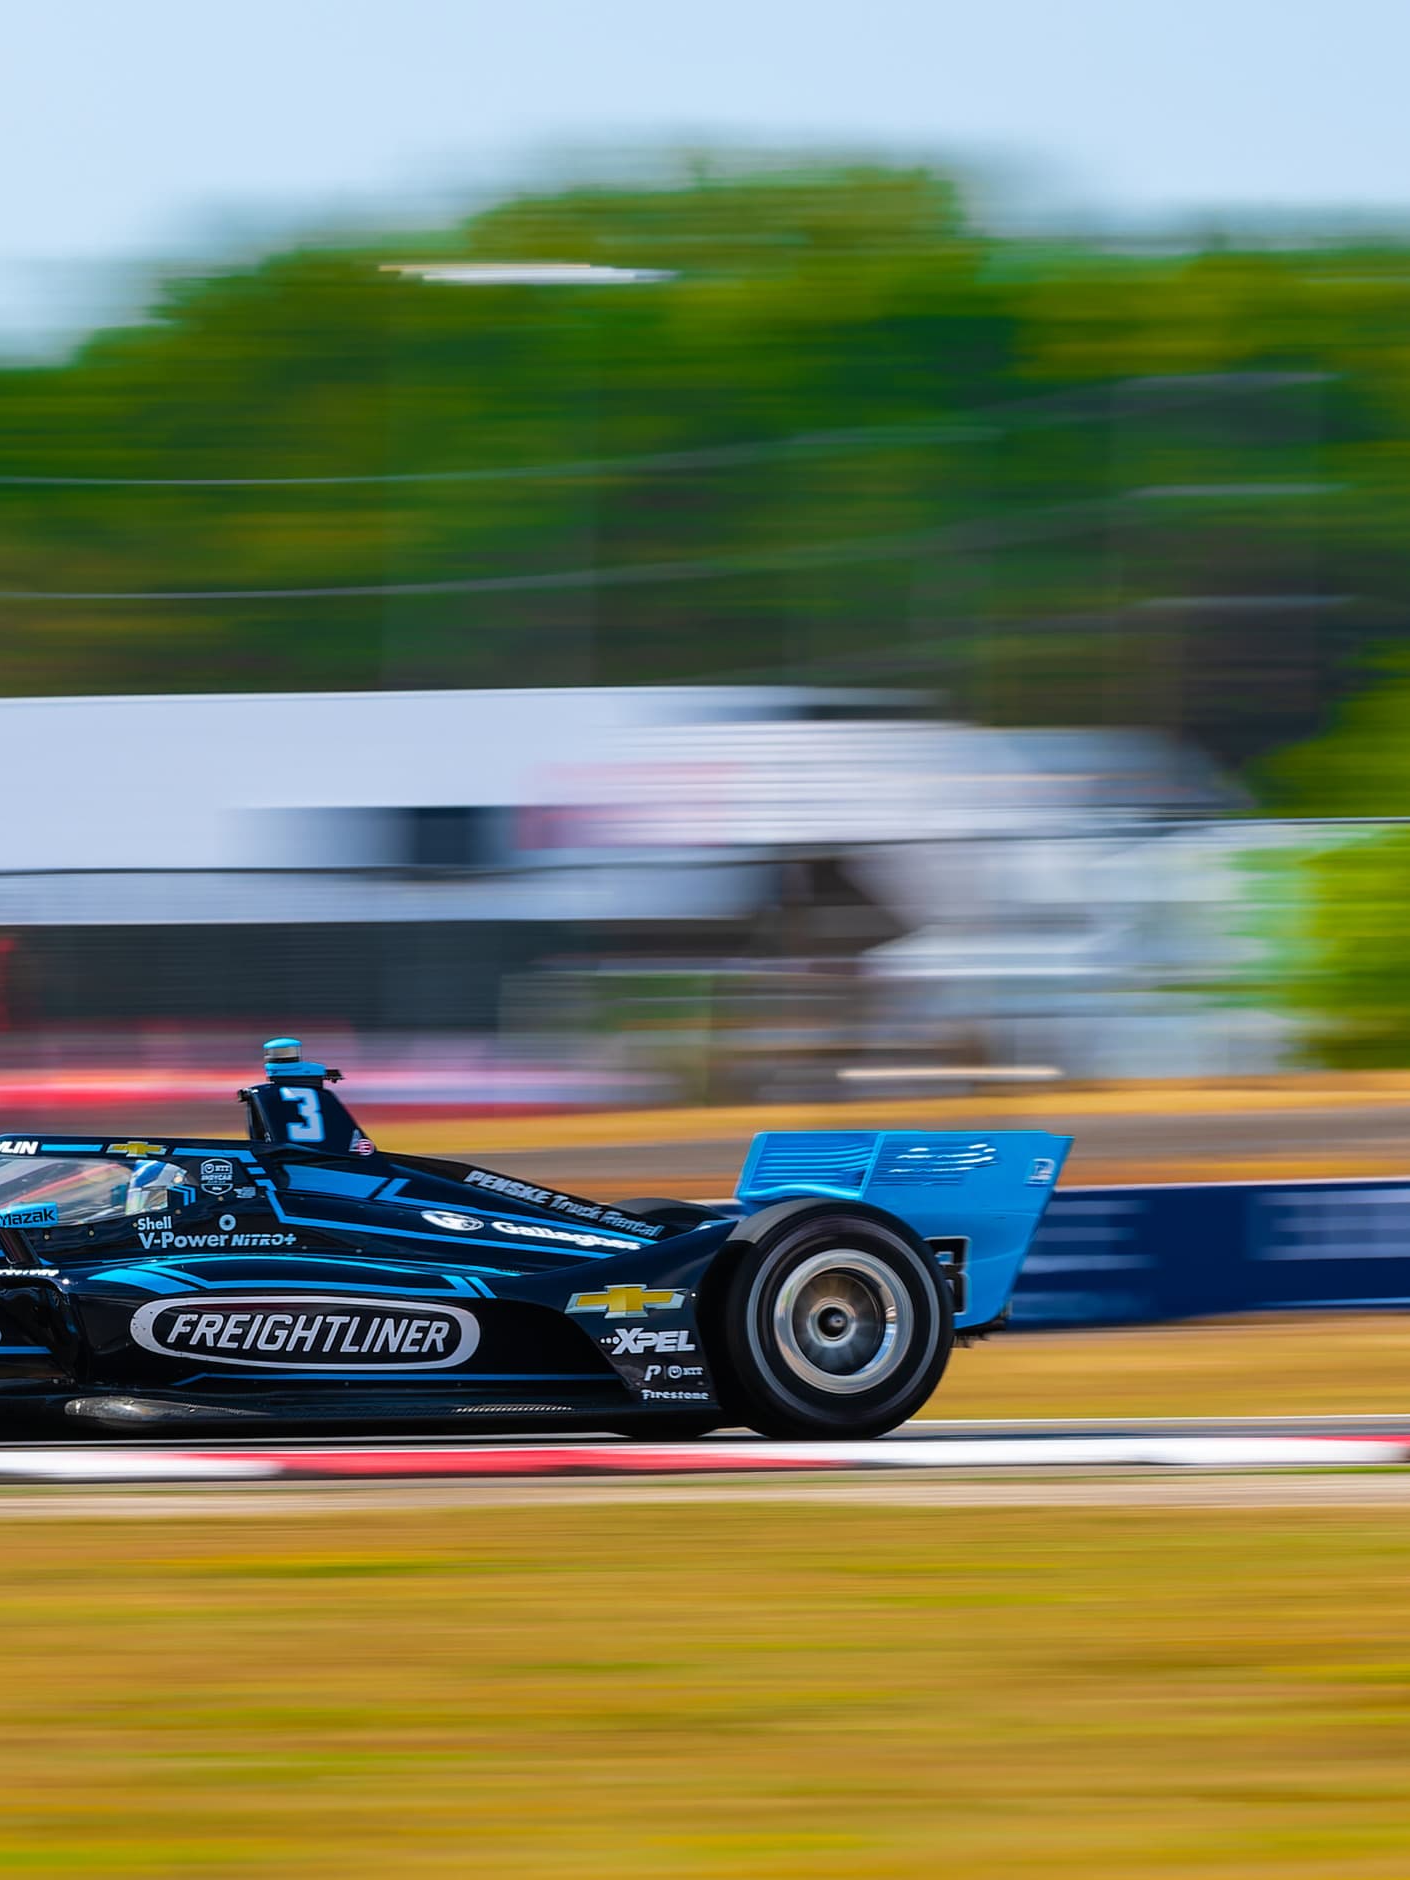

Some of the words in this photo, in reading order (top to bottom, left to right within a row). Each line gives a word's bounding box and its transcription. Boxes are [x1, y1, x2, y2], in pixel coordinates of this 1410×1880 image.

[280, 1087, 325, 1142] 3
[463, 1170, 552, 1204] PENSKE
[548, 1194, 604, 1223] Truck
[598, 1210, 665, 1238] Rental
[137, 1216, 172, 1231] Shell
[138, 1232, 228, 1248] V-Power
[166, 1313, 451, 1353] FREIGHTLINER
[611, 1327, 695, 1355] XPEL
[641, 1389, 710, 1400] Firestone
